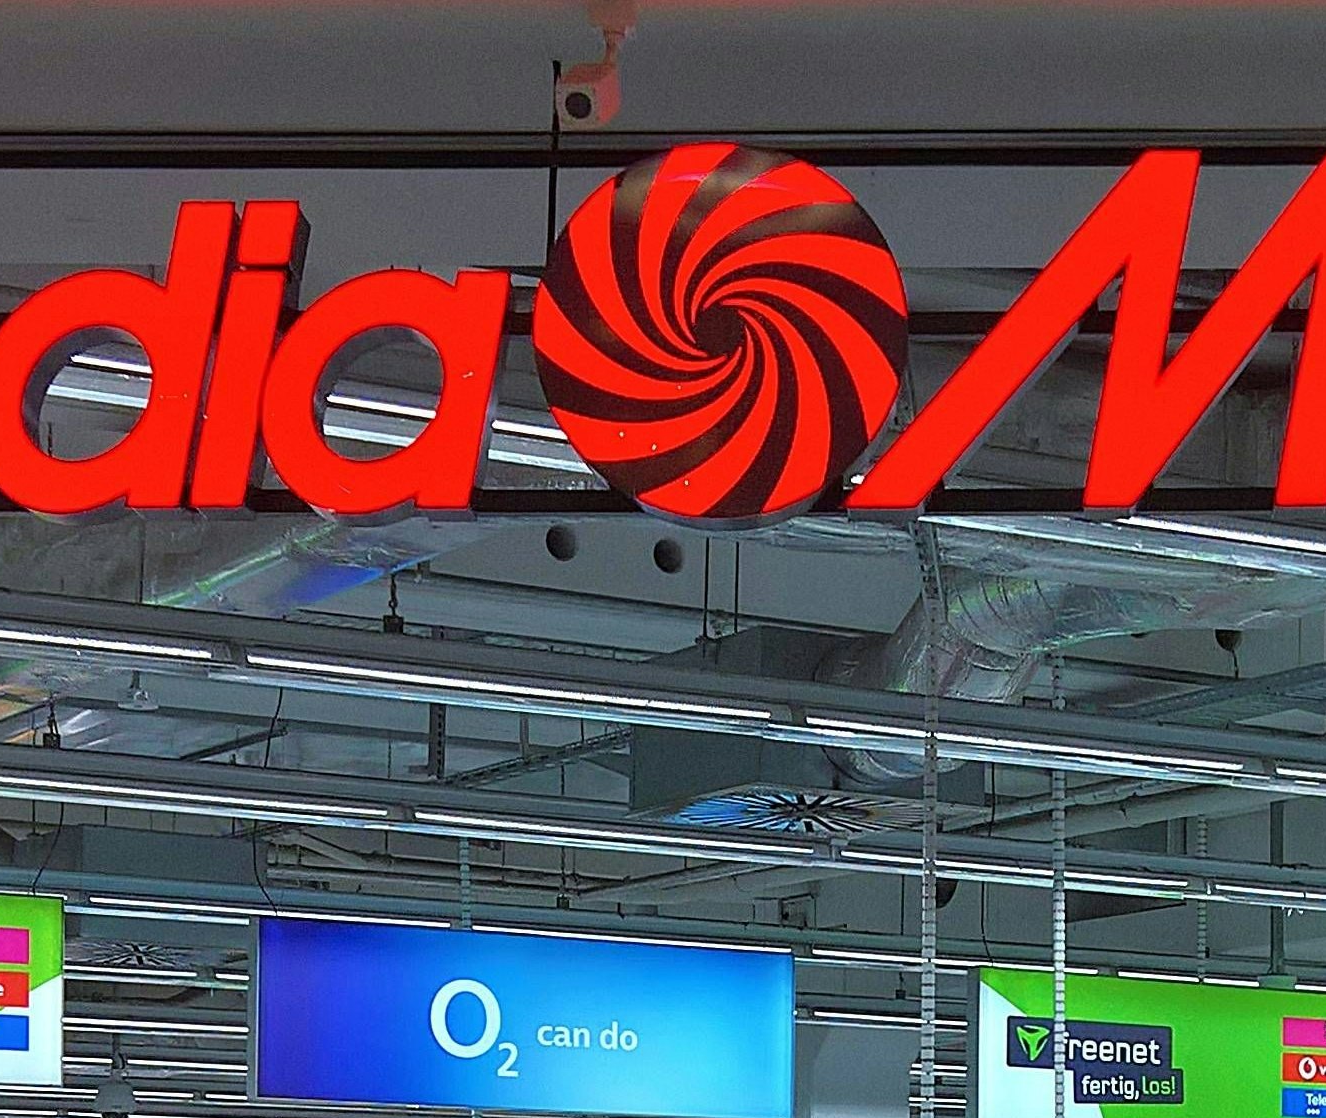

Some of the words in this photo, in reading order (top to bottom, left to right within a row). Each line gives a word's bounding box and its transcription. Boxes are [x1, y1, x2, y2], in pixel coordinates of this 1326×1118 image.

[537, 1022, 591, 1049] can
[600, 1021, 639, 1051] do
[1081, 1076, 1140, 1101] fertig,
[1141, 1076, 1176, 1096] los!
